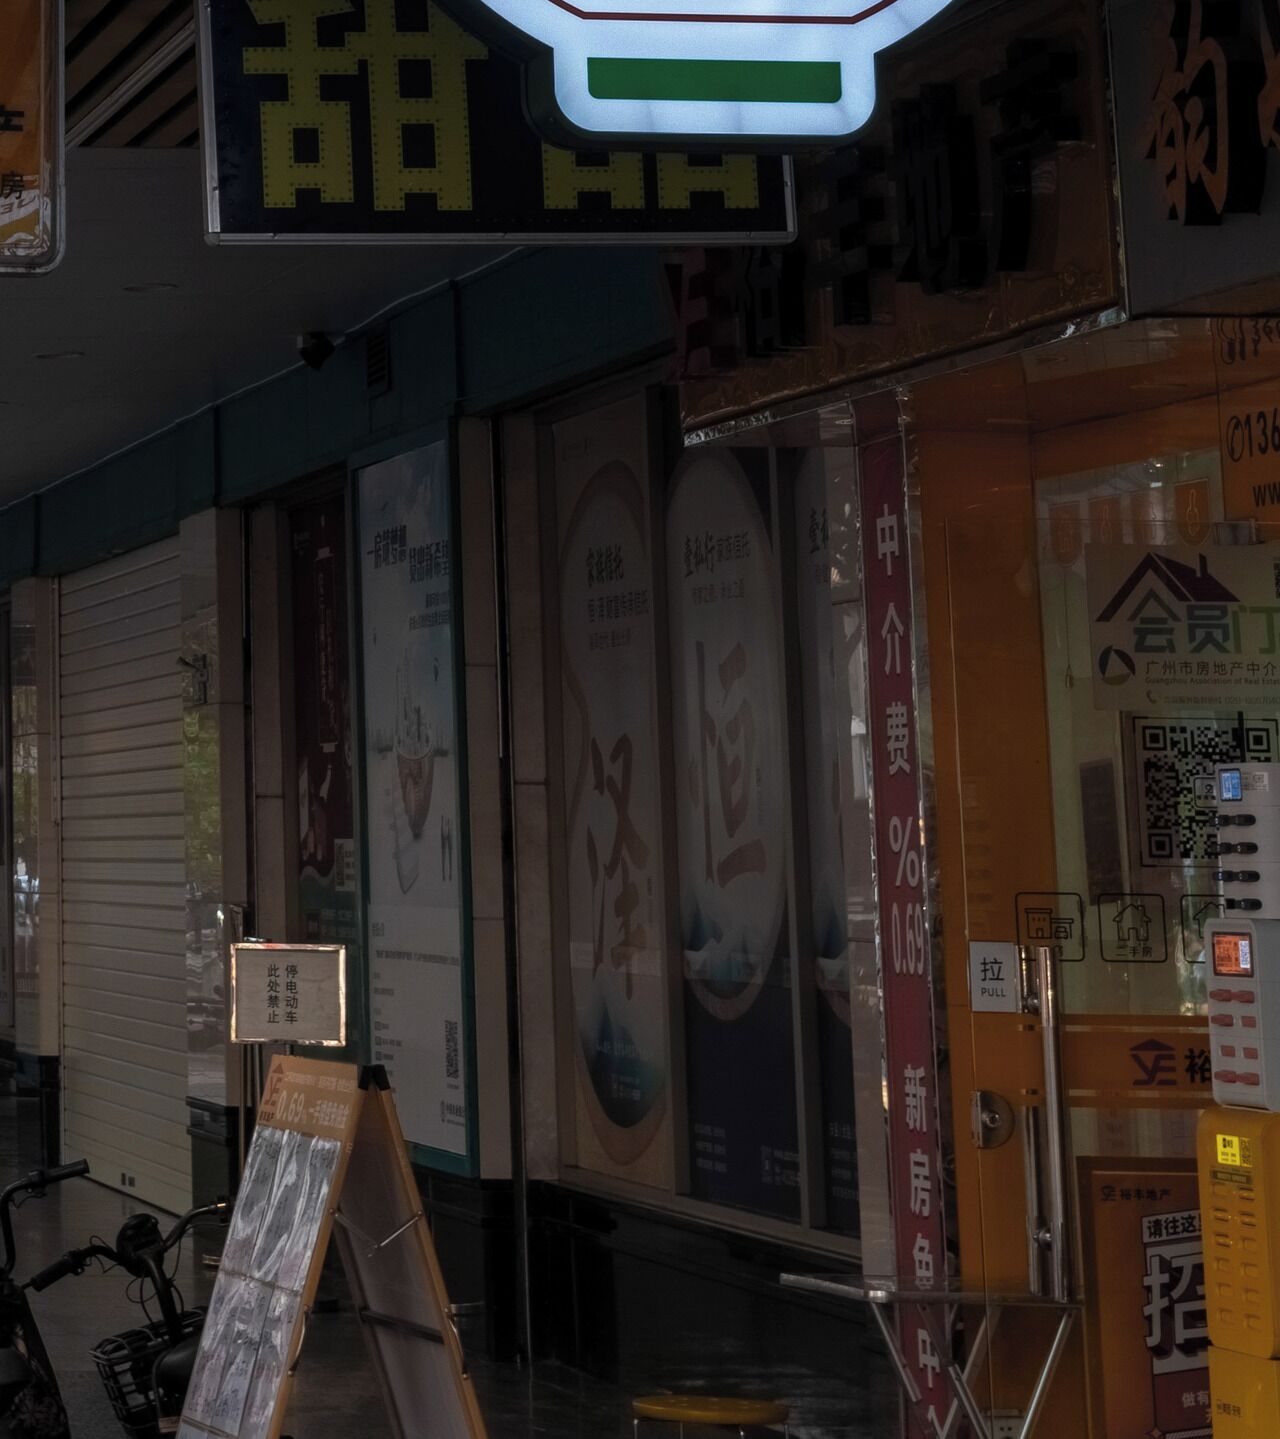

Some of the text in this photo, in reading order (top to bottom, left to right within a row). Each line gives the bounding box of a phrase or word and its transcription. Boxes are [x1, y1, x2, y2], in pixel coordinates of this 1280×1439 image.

[980, 957, 1005, 984] 拉
[266, 963, 280, 1025] 此处禁止
[284, 964, 298, 1025] 停电动车
[980, 987, 1007, 998] PULL
[1120, 1186, 1172, 1202] 裕丰地产
[1147, 1212, 1202, 1238] 请往这
